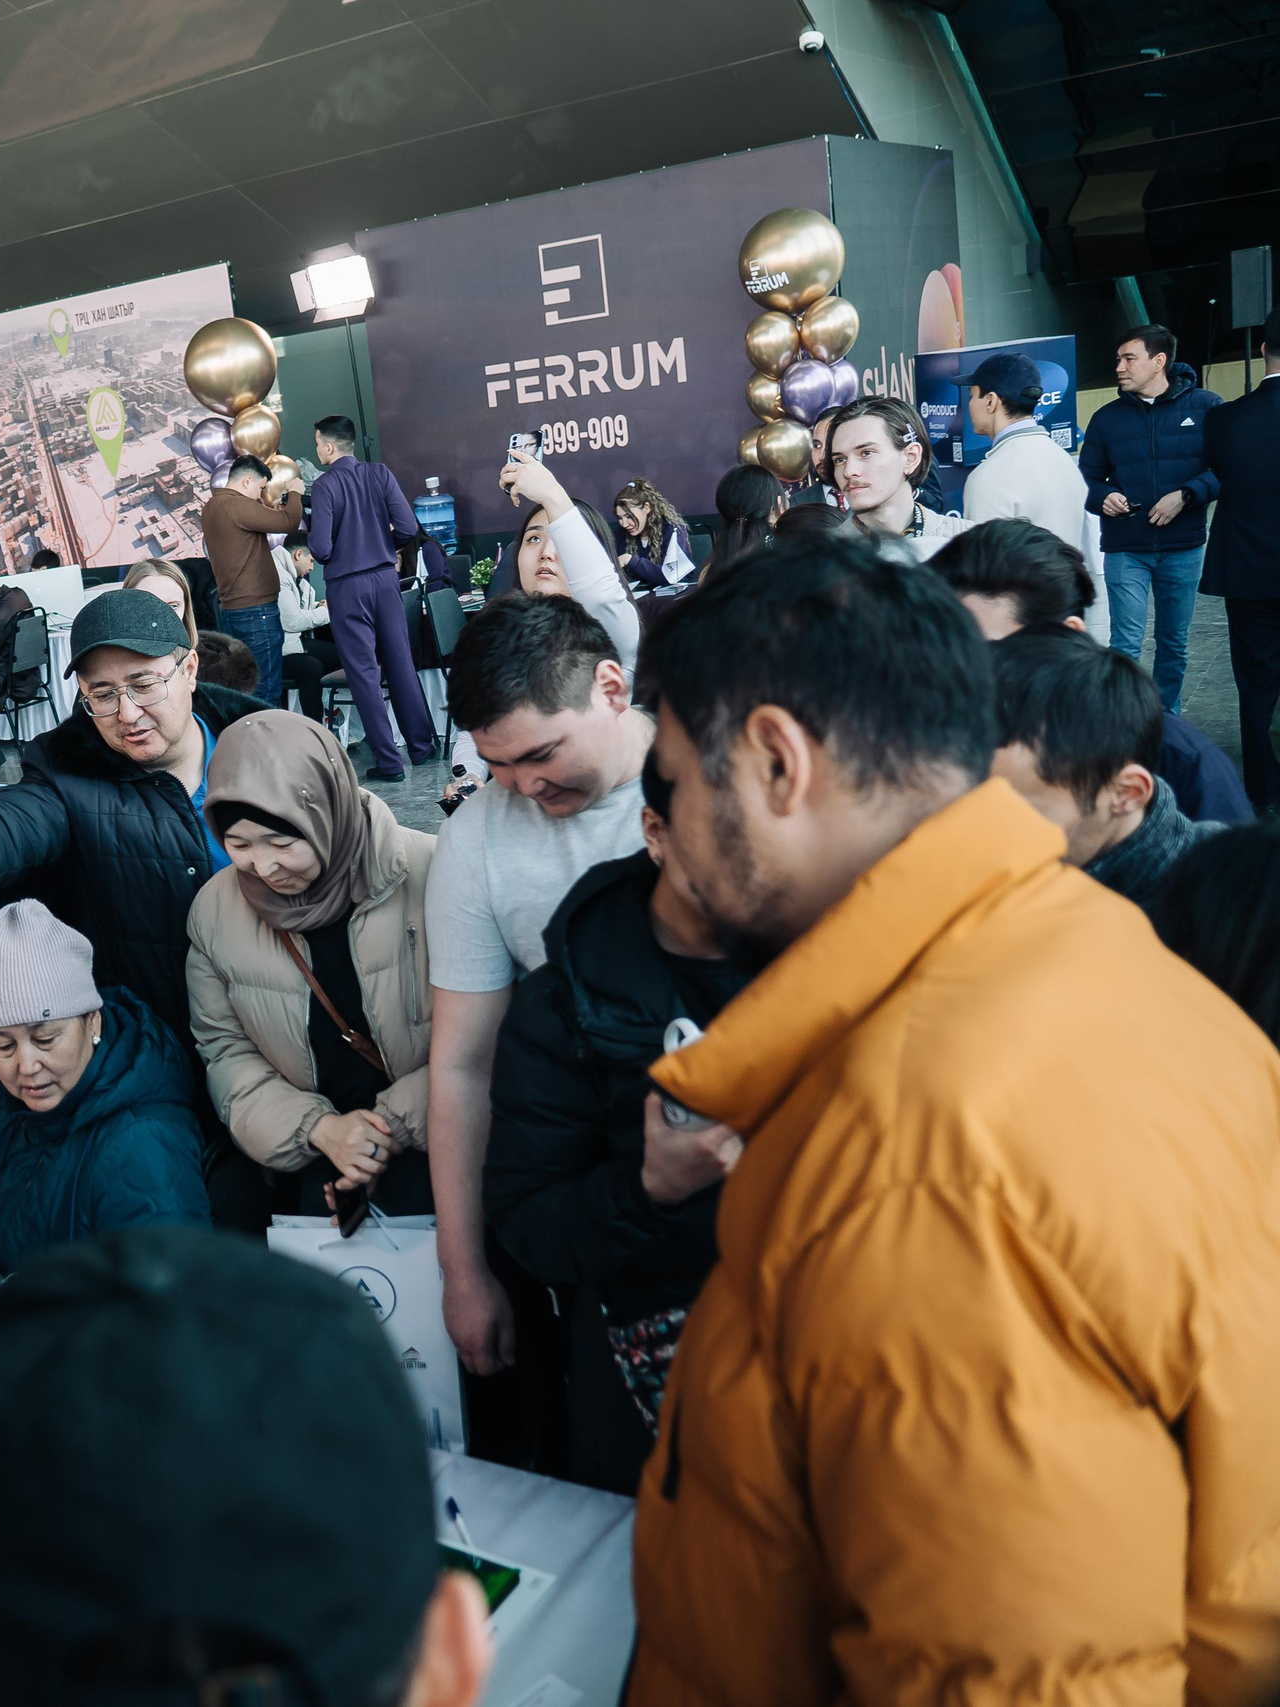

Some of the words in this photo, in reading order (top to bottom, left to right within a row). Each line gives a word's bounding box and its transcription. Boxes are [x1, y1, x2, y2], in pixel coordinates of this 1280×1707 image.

[745, 271, 790, 294] FERRUM
[75, 313, 90, 327] ТРЦ
[91, 308, 107, 324] ХАН
[107, 301, 135, 320] ШАТЫР
[485, 336, 688, 408] FERRUM
[862, 345, 916, 406] SHAN
[928, 404, 958, 417] PRODUCT
[540, 413, 630, 457] 999-909
